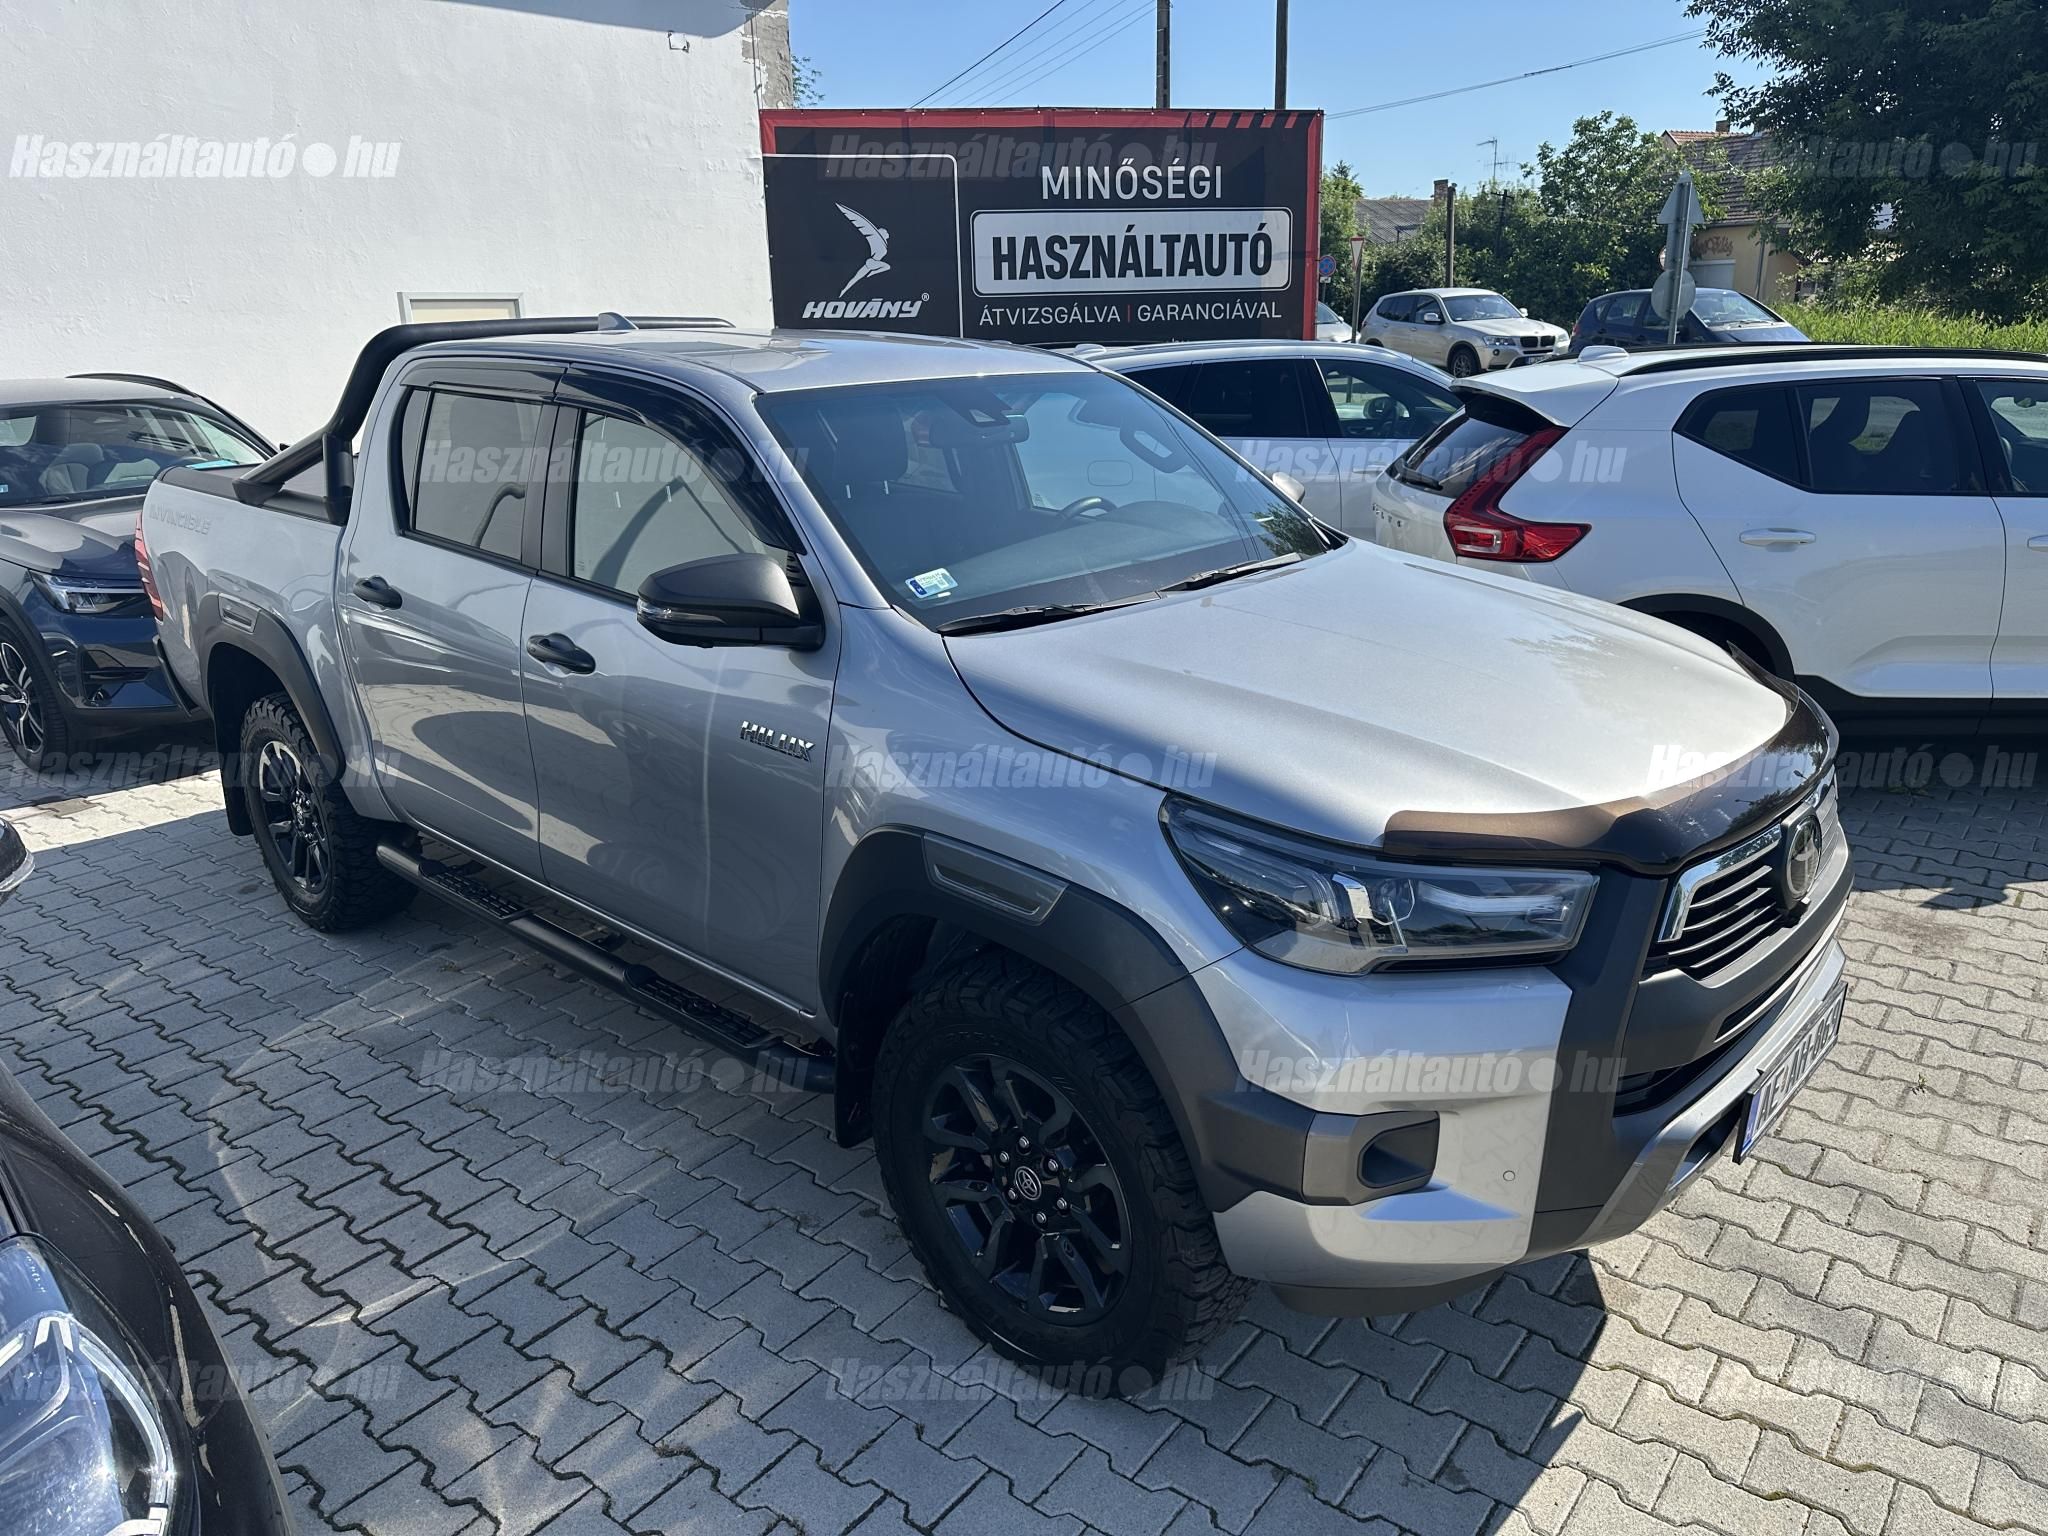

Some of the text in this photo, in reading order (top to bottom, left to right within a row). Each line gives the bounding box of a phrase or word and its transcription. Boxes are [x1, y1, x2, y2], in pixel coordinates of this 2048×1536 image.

[1042, 157, 1223, 200] MINŐSÉGI
[992, 222, 1273, 281] HASZNÁLTAUTÓ
[979, 298, 1283, 327] ÁTVIZSGÁLVA GARANCIÁVAL
[740, 720, 816, 762] HILUX
